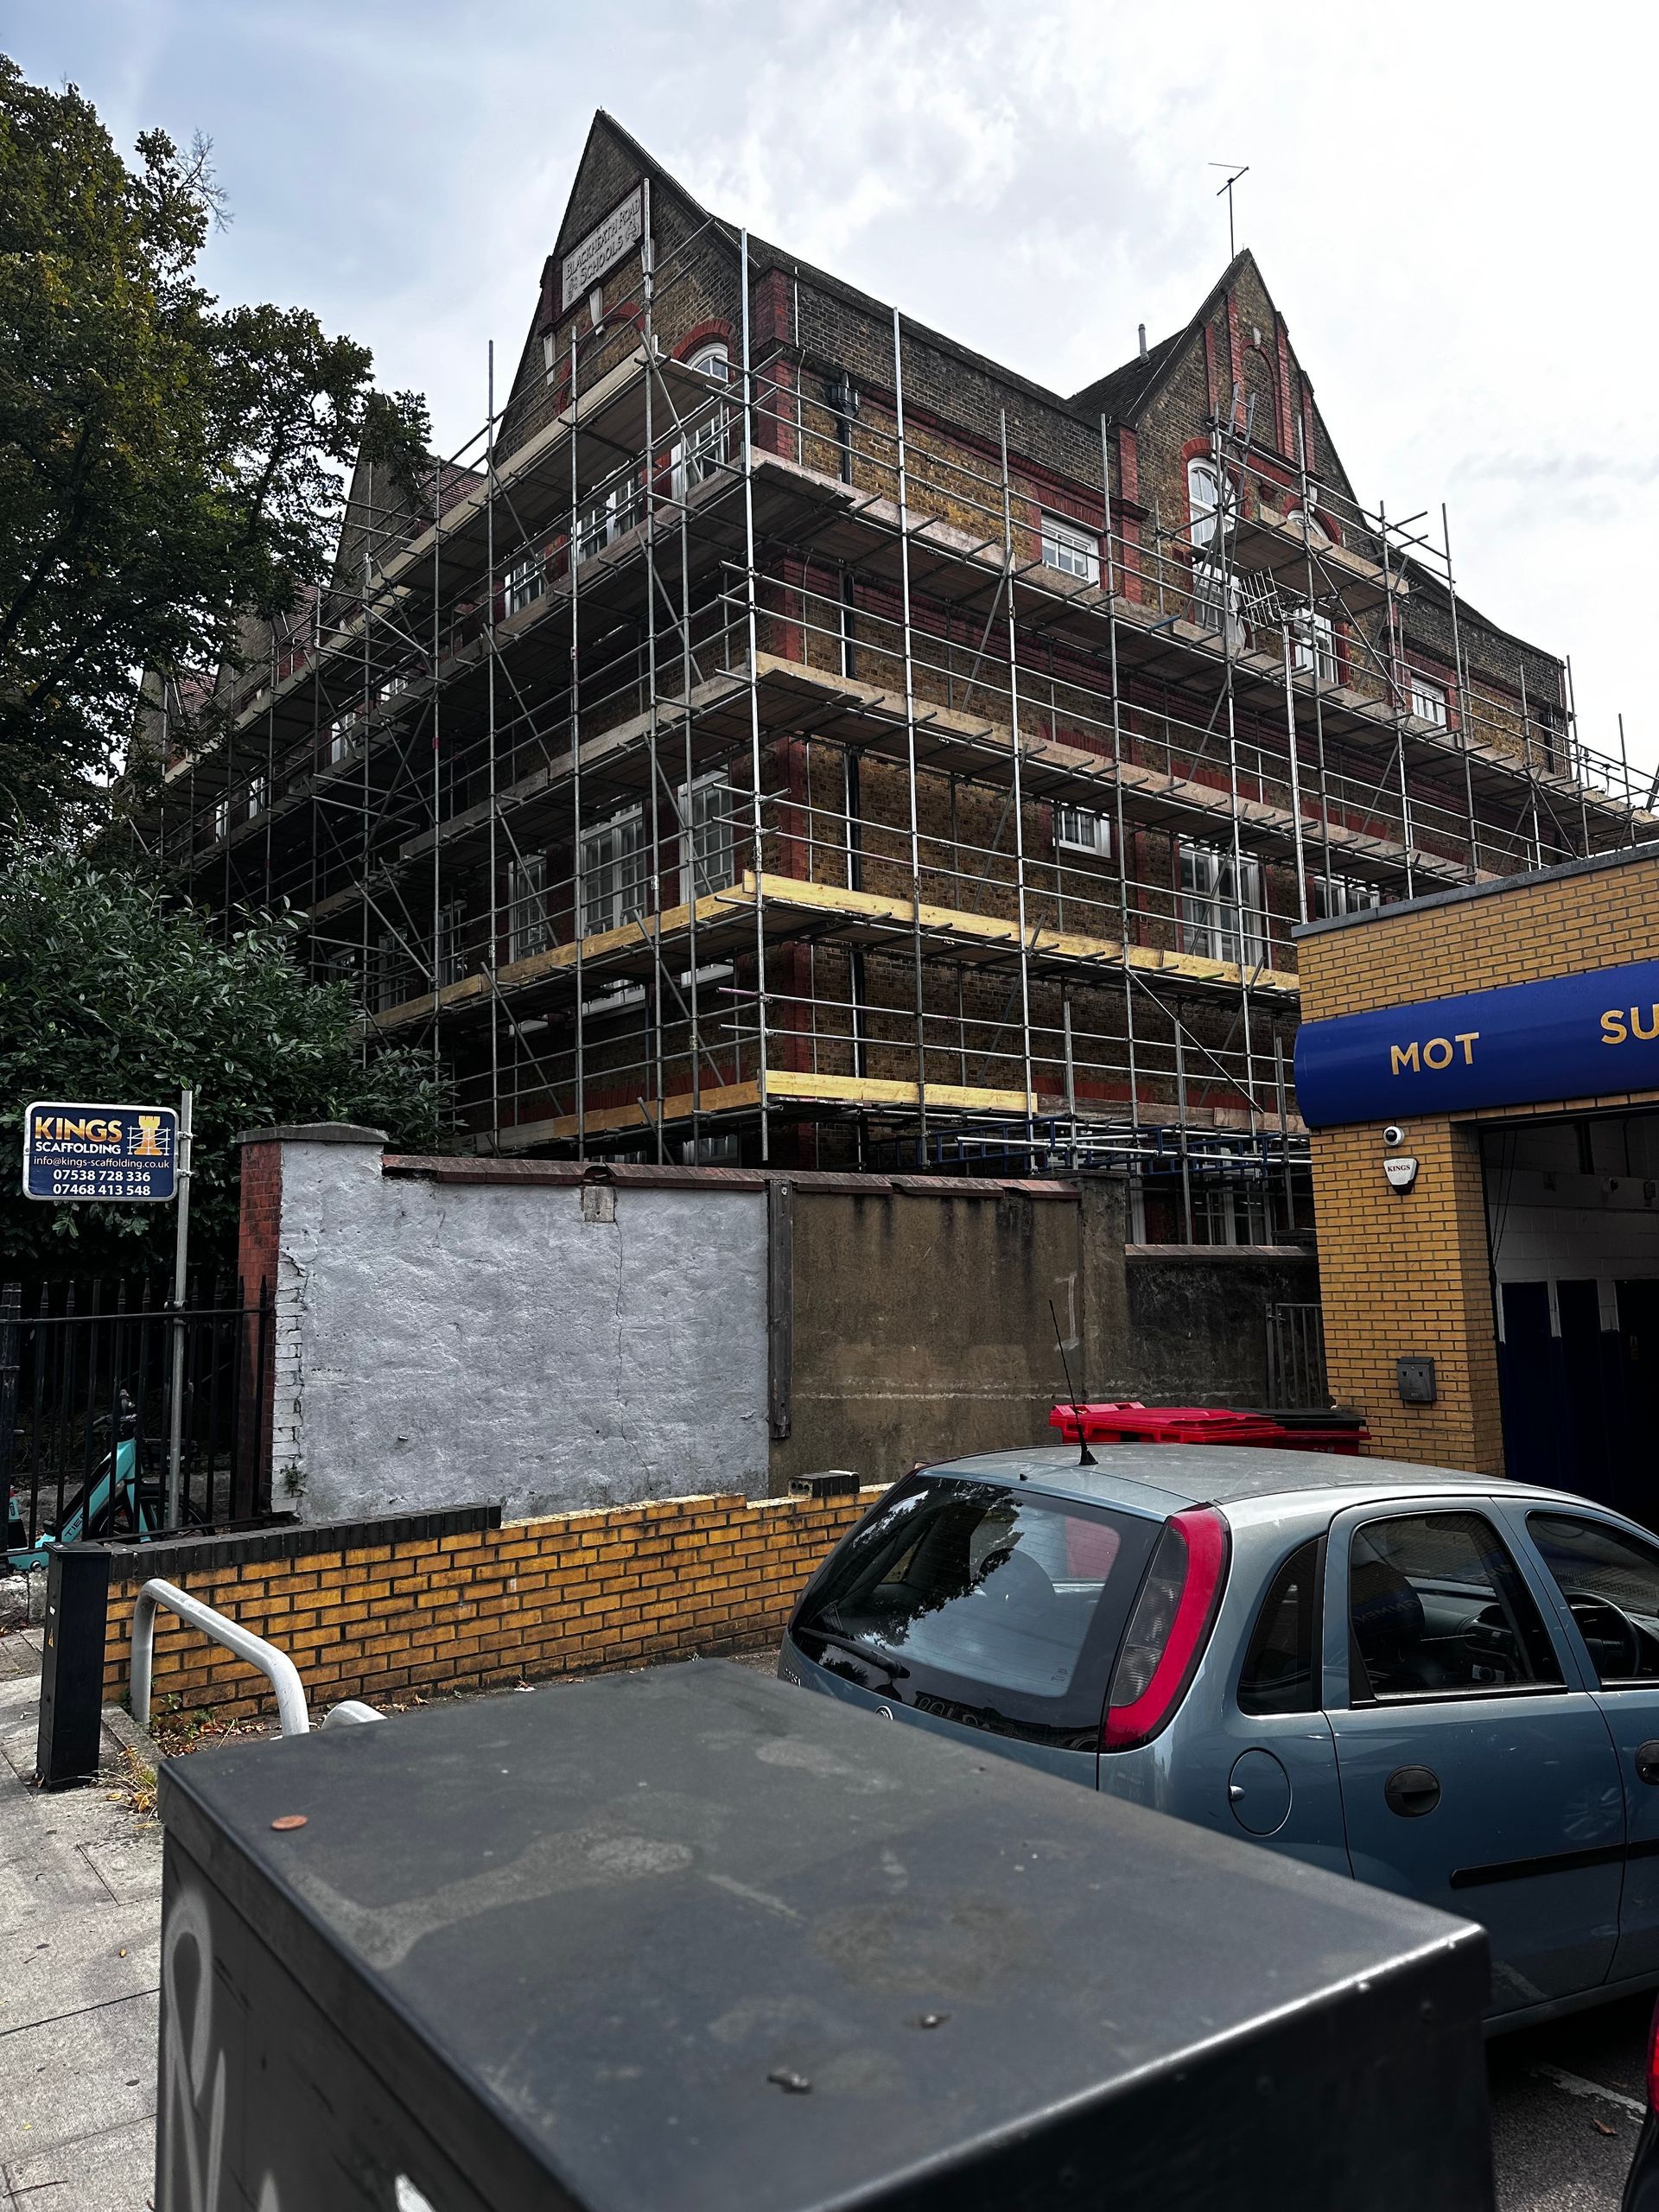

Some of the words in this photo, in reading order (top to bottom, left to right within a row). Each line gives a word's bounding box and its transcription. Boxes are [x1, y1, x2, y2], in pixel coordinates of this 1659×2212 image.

[618, 198, 640, 230] ROAD
[580, 236, 623, 285] SCHOOLS
[1600, 1003, 1659, 1045] SU
[1389, 1032, 1480, 1075] MOT
[35, 1116, 123, 1143] KINGS
[35, 1141, 121, 1154] SCAFFOLDING
[34, 1156, 170, 1170] info@kings-scaffolding.co.uk
[53, 1169, 96, 1181] 07538
[99, 1170, 124, 1182] 728
[126, 1171, 151, 1182] 336
[53, 1183, 96, 1195] 07468
[98, 1184, 124, 1196] 413
[126, 1185, 151, 1196] 548
